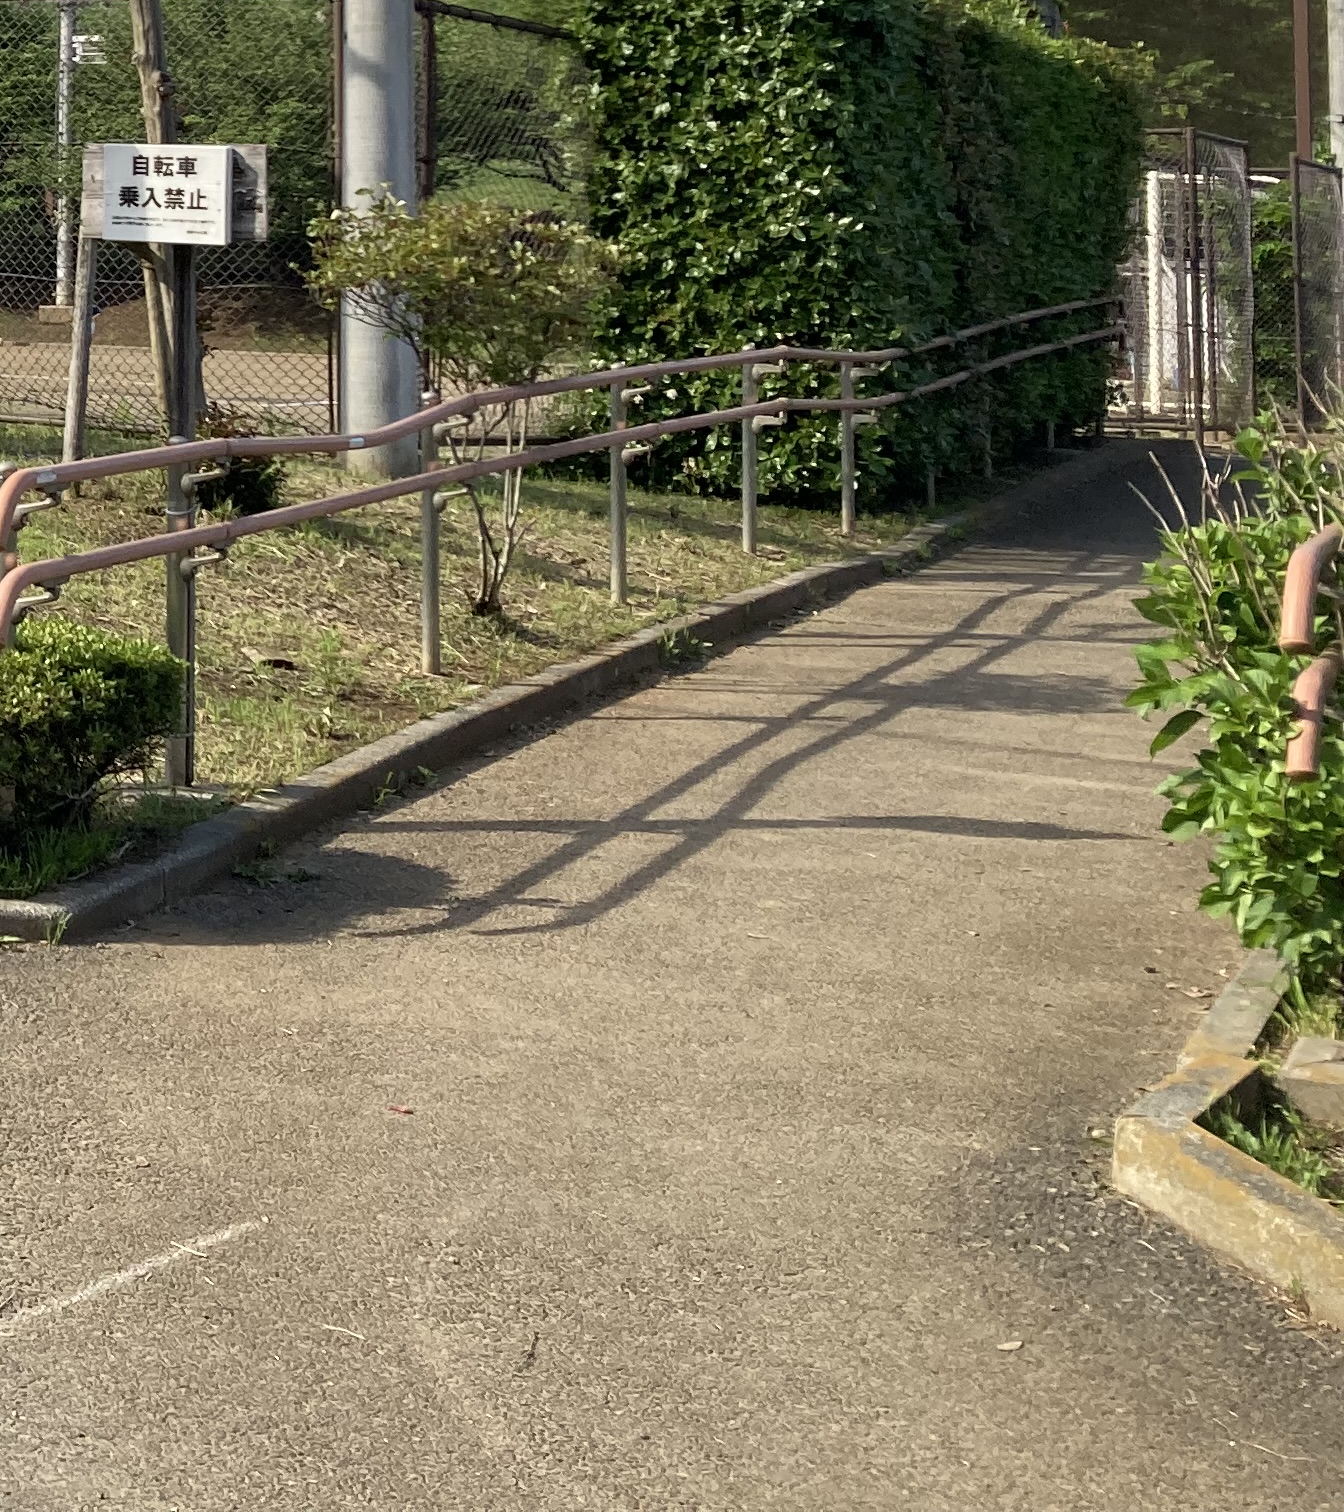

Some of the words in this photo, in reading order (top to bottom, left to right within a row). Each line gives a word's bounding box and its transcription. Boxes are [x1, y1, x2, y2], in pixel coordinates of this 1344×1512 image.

[132, 154, 198, 178] 自転車
[118, 185, 209, 210] 乗入禁止
